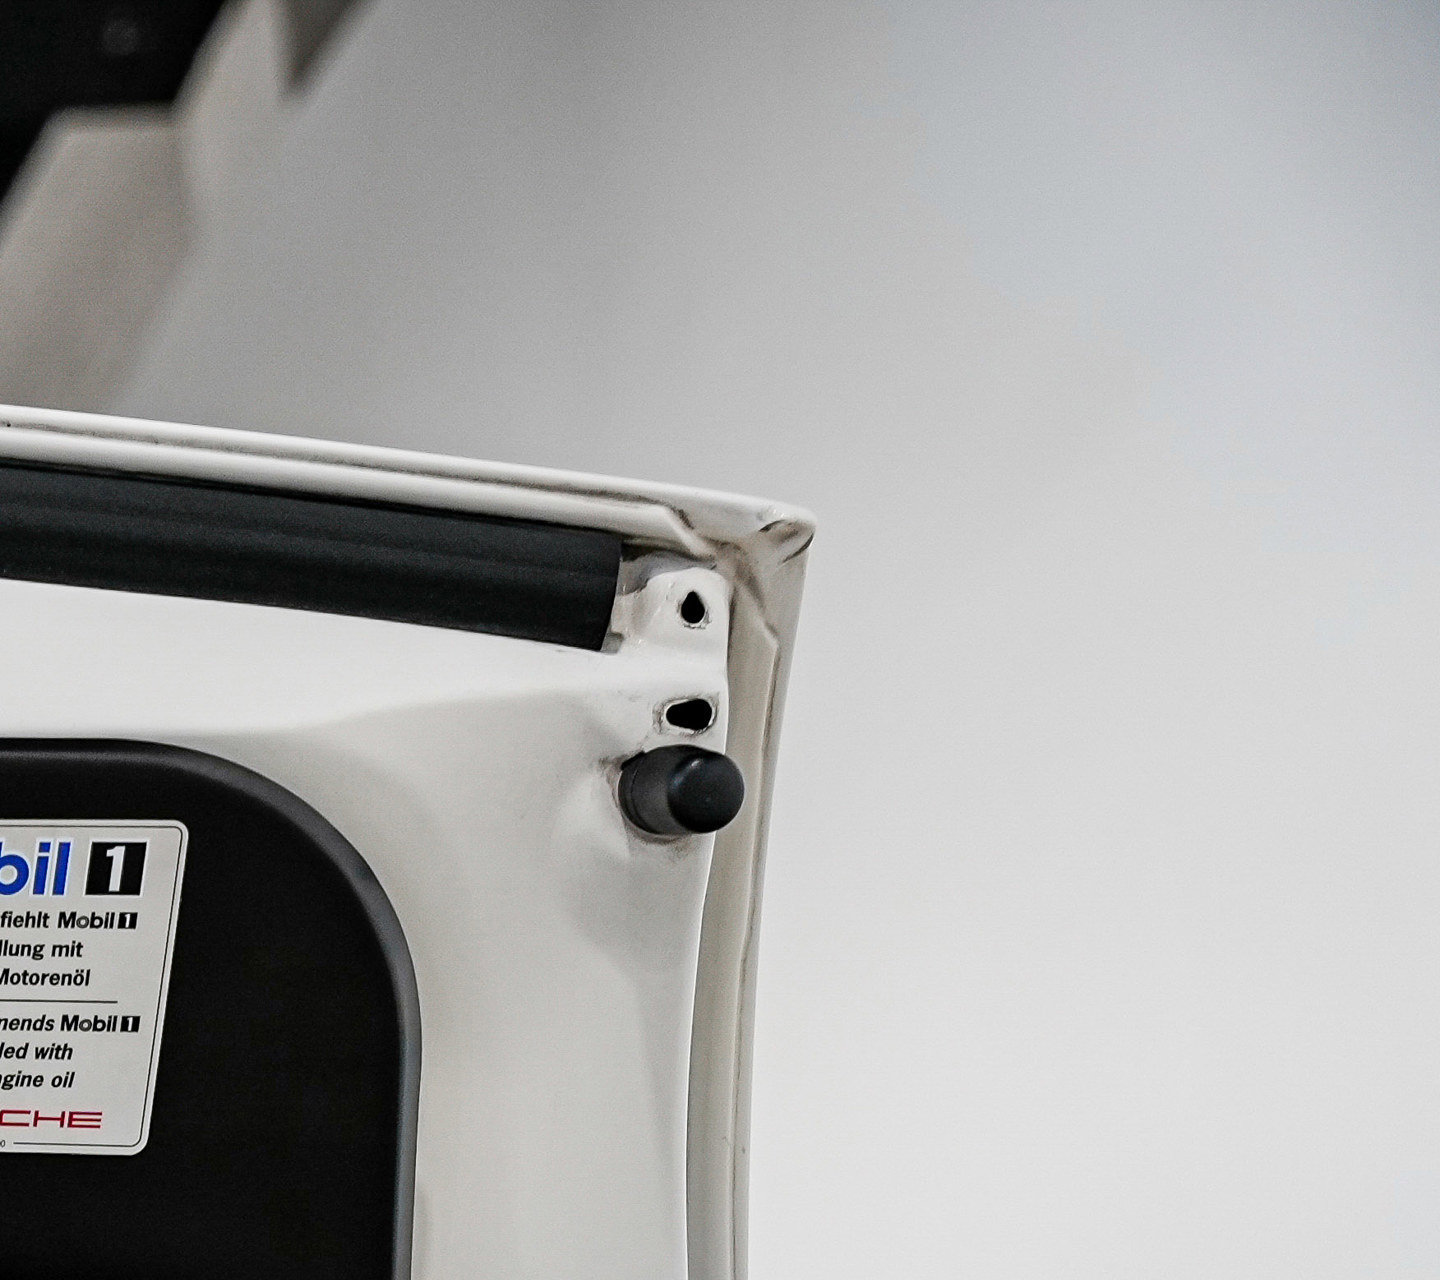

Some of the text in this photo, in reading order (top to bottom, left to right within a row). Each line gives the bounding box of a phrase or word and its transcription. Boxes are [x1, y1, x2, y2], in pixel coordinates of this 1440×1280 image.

[51, 941, 83, 958] mit
[34, 1043, 73, 1060] with
[51, 1071, 75, 1089] oil
